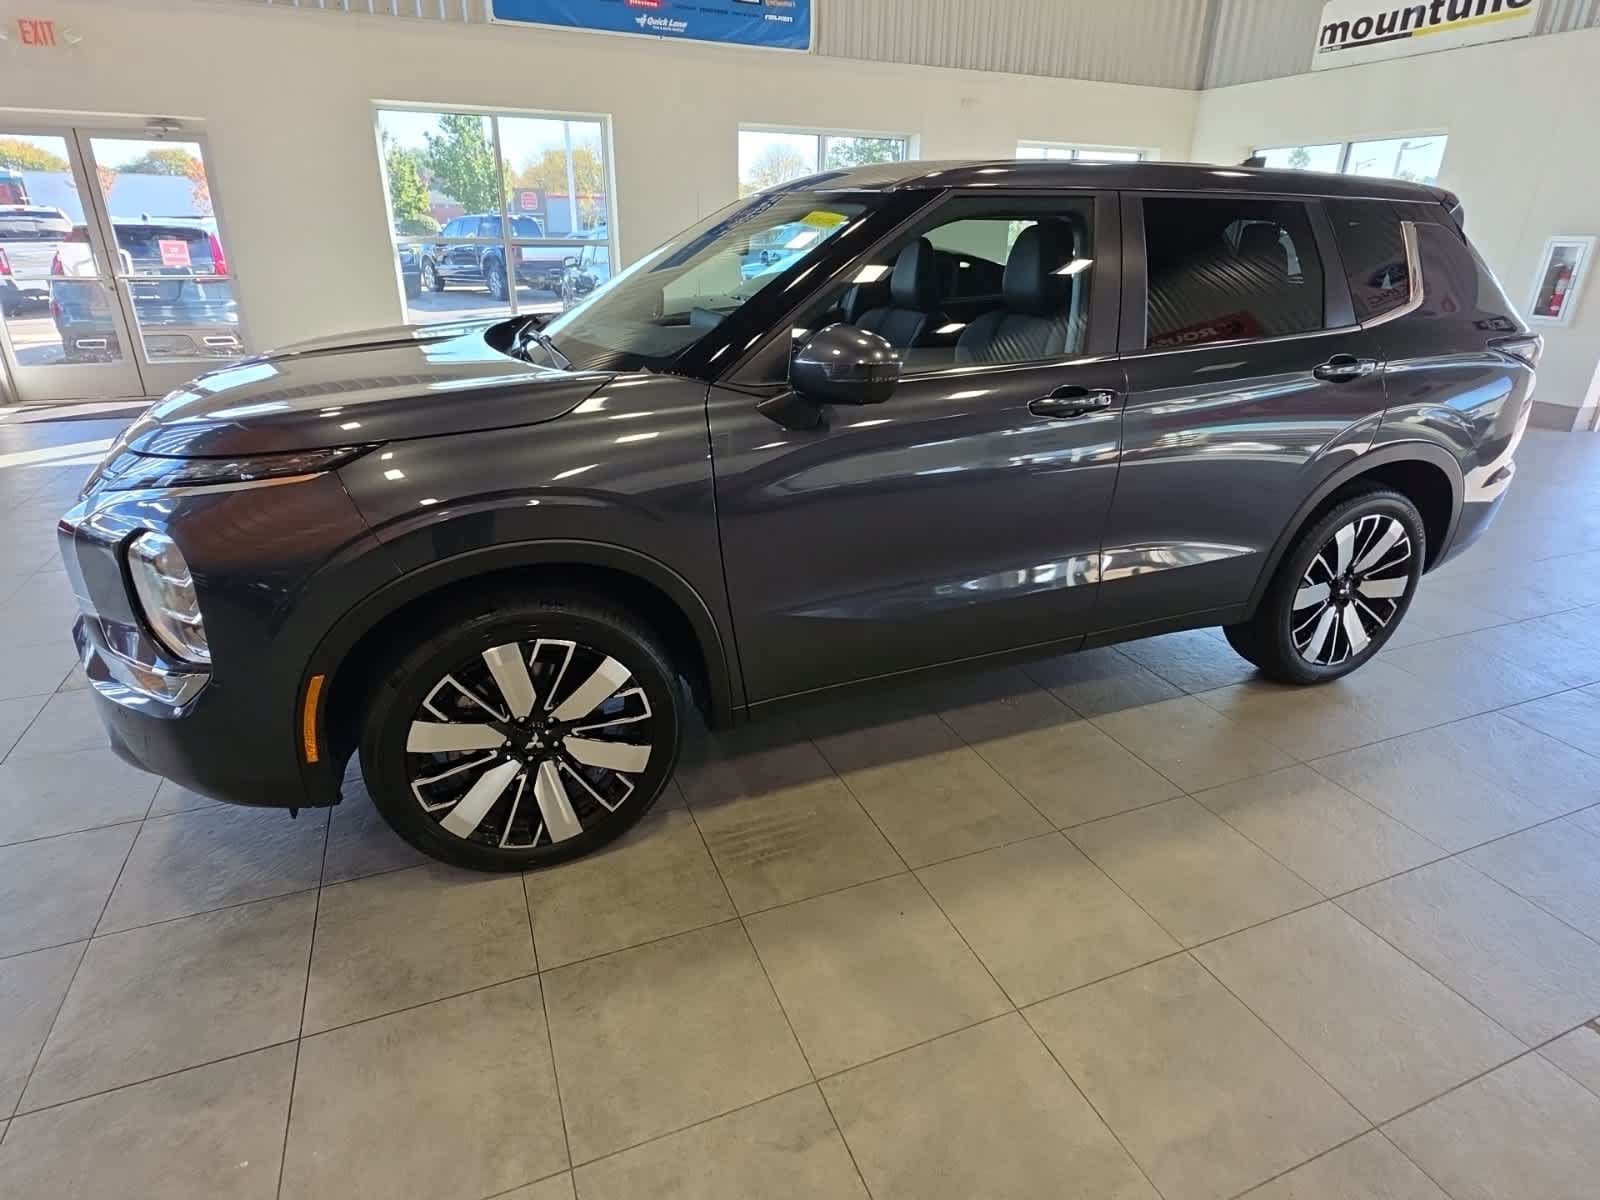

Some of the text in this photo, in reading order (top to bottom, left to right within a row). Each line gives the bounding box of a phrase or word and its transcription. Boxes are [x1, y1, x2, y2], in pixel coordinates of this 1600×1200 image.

[647, 16, 688, 28] Quick Lane
[17, 18, 57, 47] EXIT
